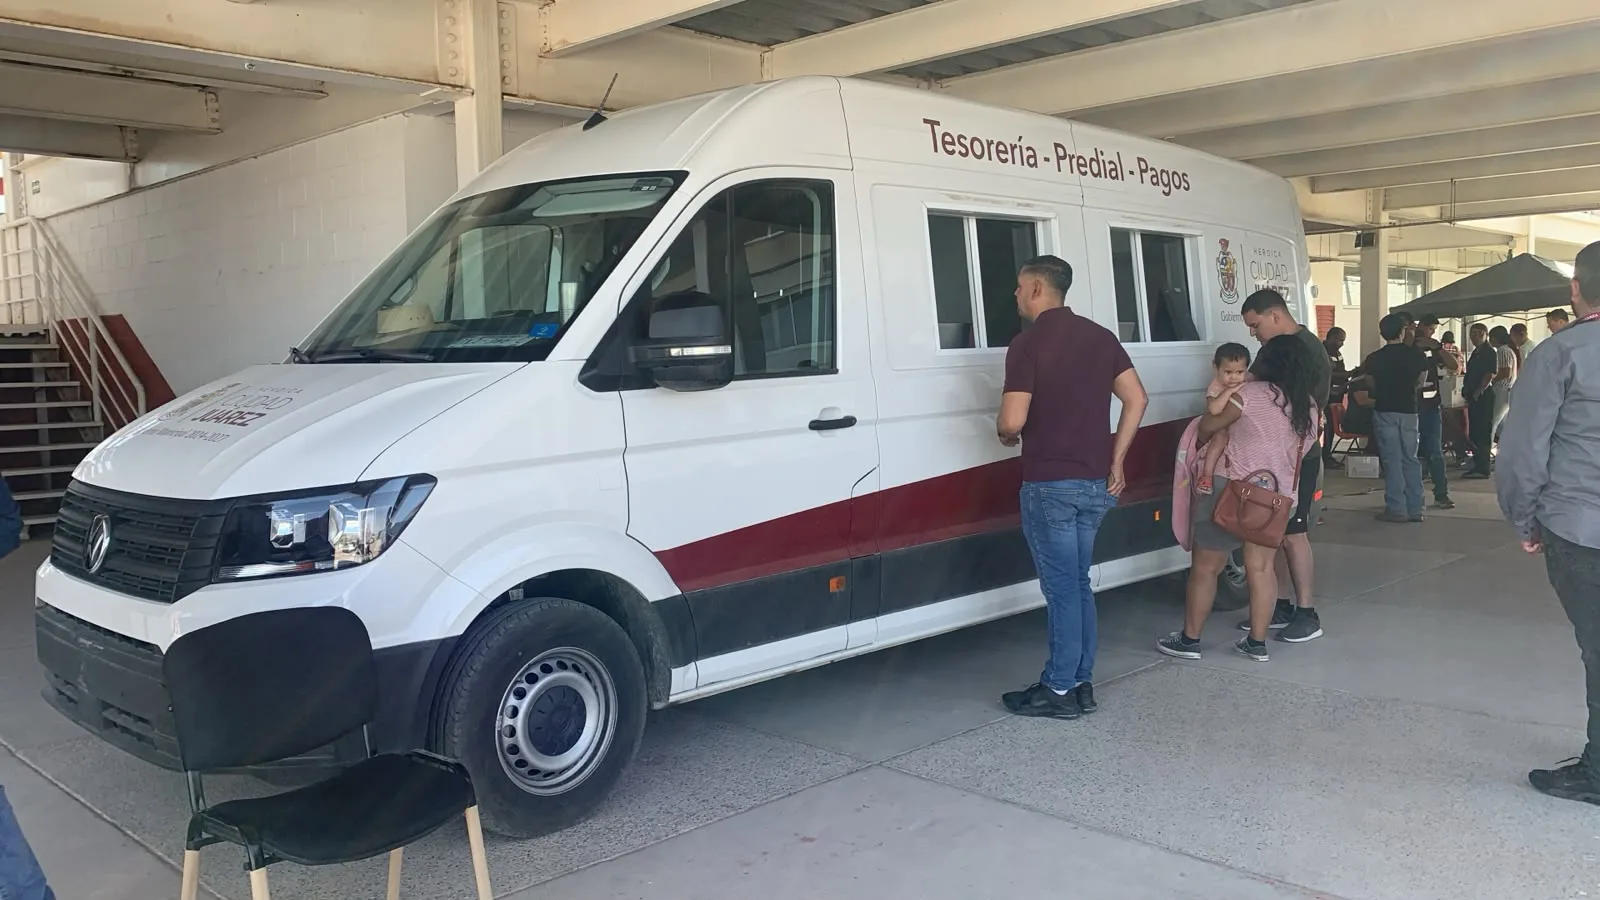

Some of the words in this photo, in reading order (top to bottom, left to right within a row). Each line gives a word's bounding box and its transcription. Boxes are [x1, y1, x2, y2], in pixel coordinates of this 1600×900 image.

[923, 118, 1038, 168] Tesorería
[1053, 142, 1125, 181] Predial
[1137, 157, 1190, 196] Pagos
[1253, 248, 1281, 257] HEROICA
[1250, 260, 1288, 282] CIUDAD
[221, 394, 293, 410] CIUDAD
